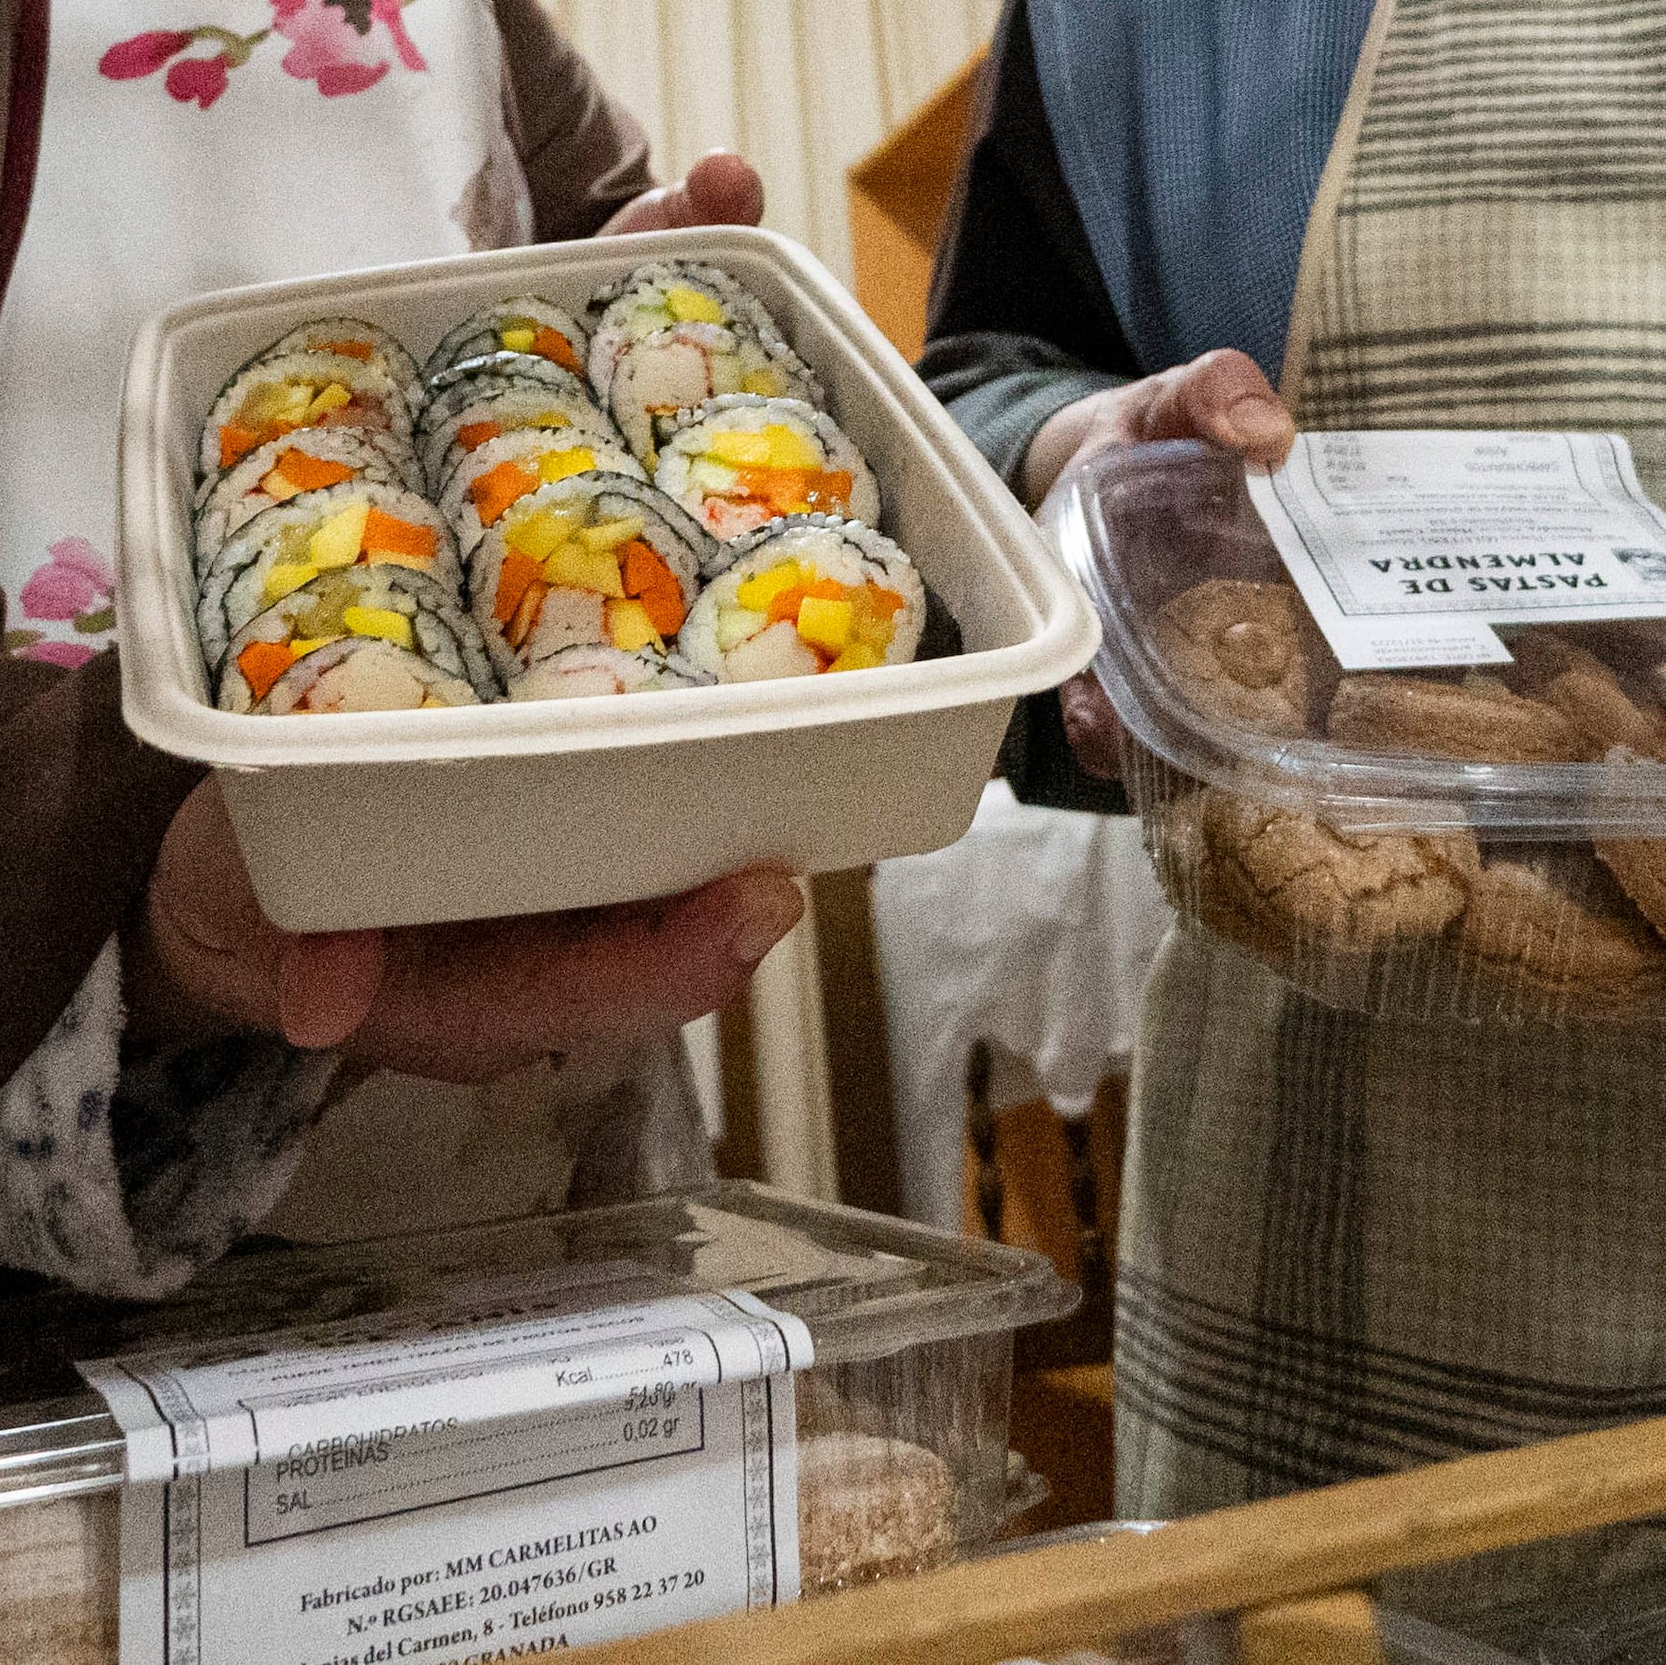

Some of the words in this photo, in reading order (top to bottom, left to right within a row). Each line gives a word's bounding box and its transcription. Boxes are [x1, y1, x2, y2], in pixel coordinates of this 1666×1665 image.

[1369, 552, 1585, 573] ALMENDRA
[1468, 573, 1608, 592] PASTAS
[1400, 578, 1453, 594] DE
[556, 1367, 593, 1387] Kcal
[663, 1349, 694, 1367] 478
[276, 1442, 391, 1484] PROTEINAS
[276, 1488, 312, 1514] SAL
[623, 1418, 659, 1442] 0,02
[662, 1416, 680, 1439] gr
[300, 1575, 396, 1612] Fabricado
[400, 1567, 440, 1595] por:
[444, 1554, 483, 1580] MM
[489, 1522, 624, 1569] CARMELITAS
[627, 1515, 658, 1537] AO
[382, 1590, 474, 1628] RGSAEE:
[479, 1556, 618, 1605] 20.047636/GR
[364, 1640, 393, 1665] del
[397, 1626, 479, 1658] Carmen,
[482, 1617, 494, 1636] 8
[508, 1598, 589, 1630] Teléfono
[593, 1589, 628, 1612] 958
[632, 1582, 654, 1602] 22
[658, 1575, 679, 1596] 37
[683, 1568, 706, 1589] 20
[464, 1633, 570, 1665] GRANADA
